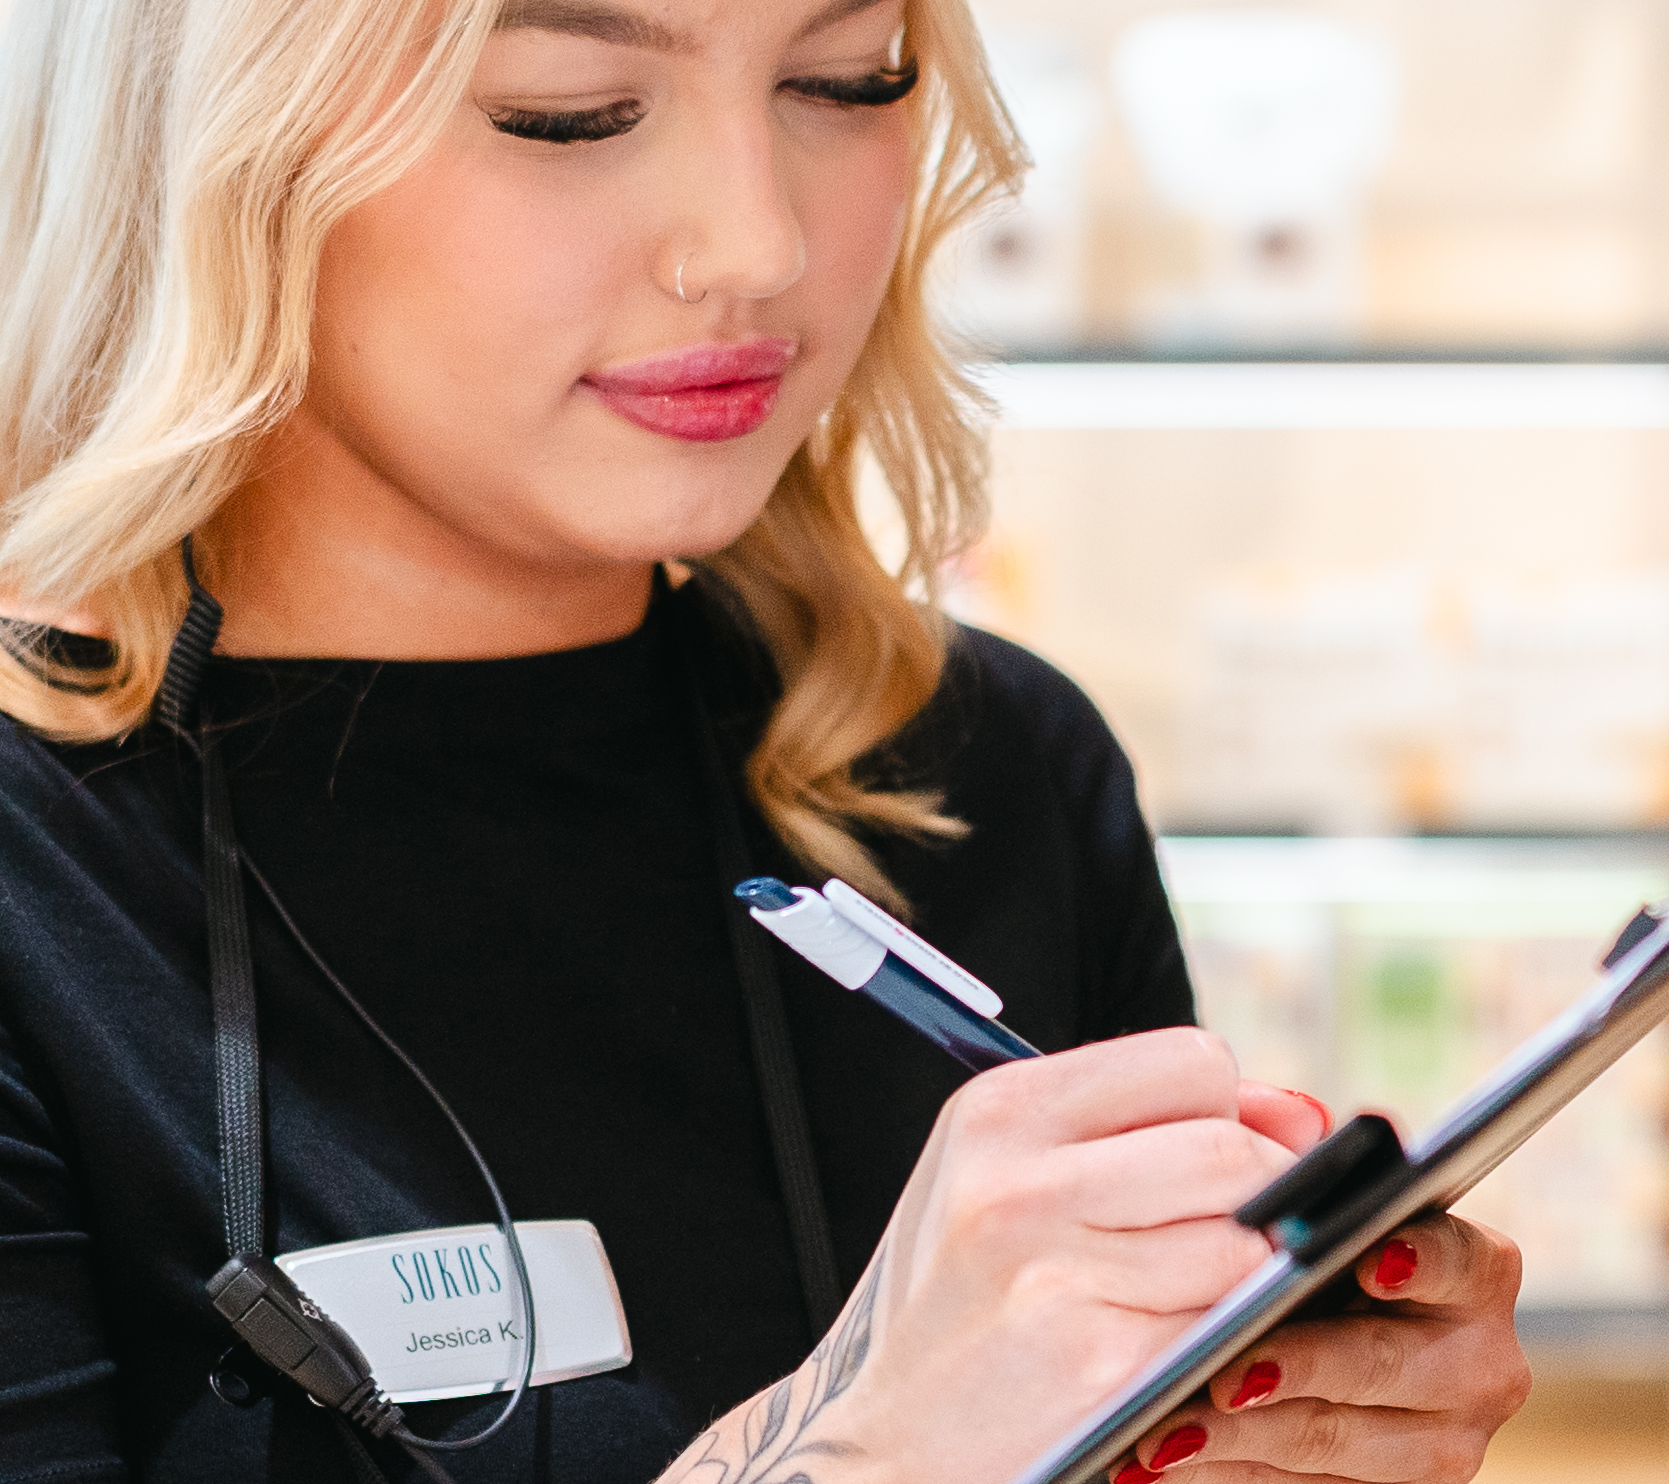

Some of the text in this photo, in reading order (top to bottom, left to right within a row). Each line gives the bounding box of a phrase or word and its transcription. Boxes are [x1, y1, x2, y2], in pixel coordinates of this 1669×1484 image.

[391, 1243, 502, 1304] SOKOS
[406, 1319, 524, 1354] Jessica K.
